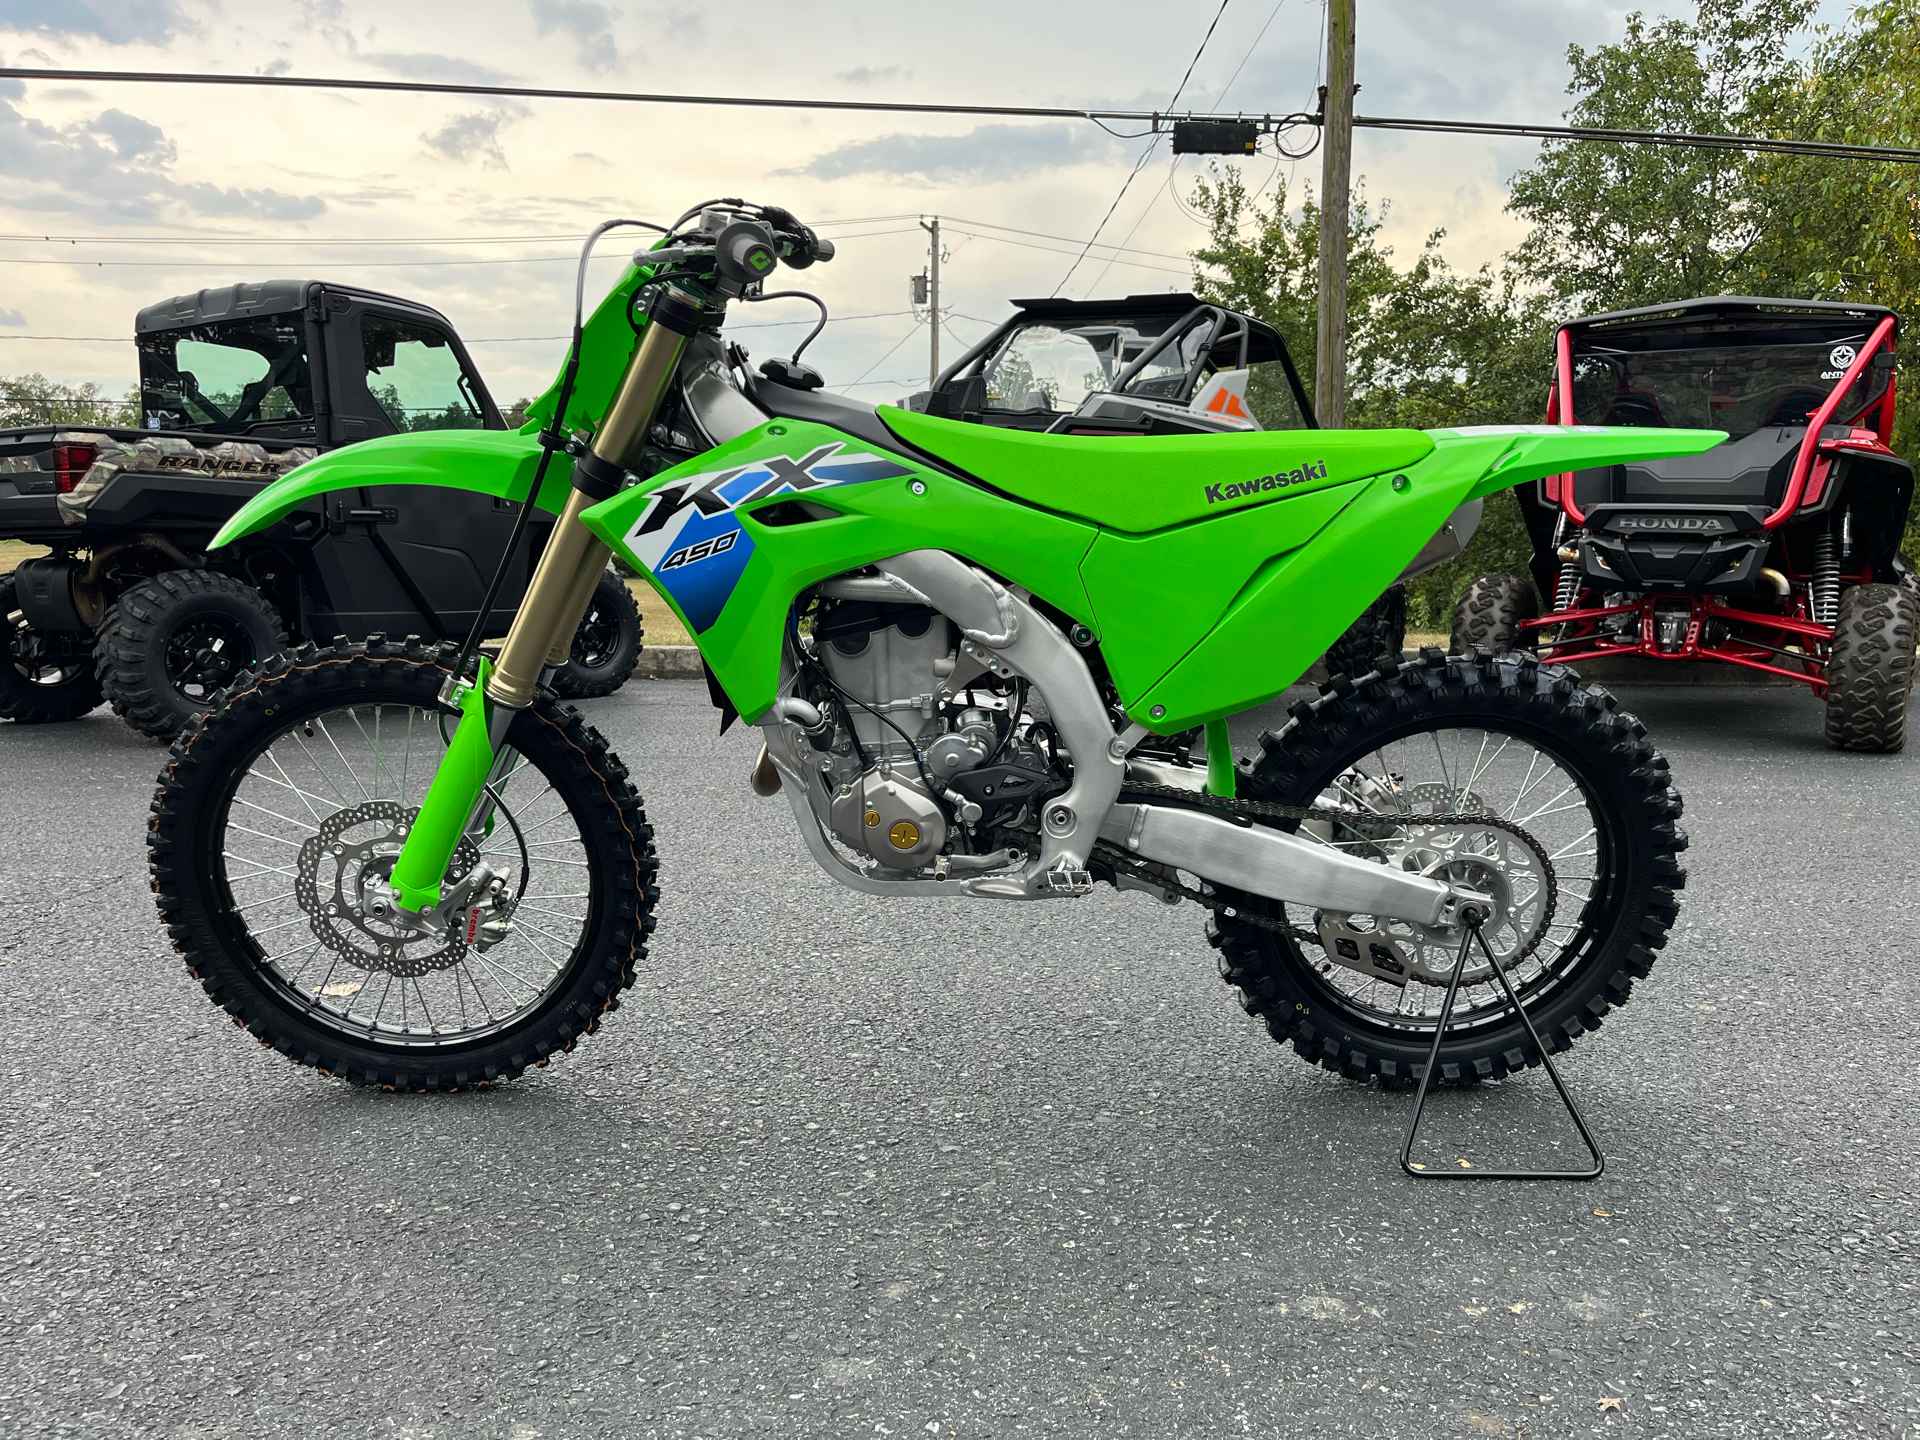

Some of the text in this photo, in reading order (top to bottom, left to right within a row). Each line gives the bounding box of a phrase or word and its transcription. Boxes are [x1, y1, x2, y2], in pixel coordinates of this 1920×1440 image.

[156, 455, 283, 475] RANGER
[1203, 459, 1328, 505] Kawasaki
[633, 440, 848, 538] KX
[1617, 517, 1725, 531] HONDA
[660, 528, 741, 572] 450
[466, 908, 482, 945] brembo
